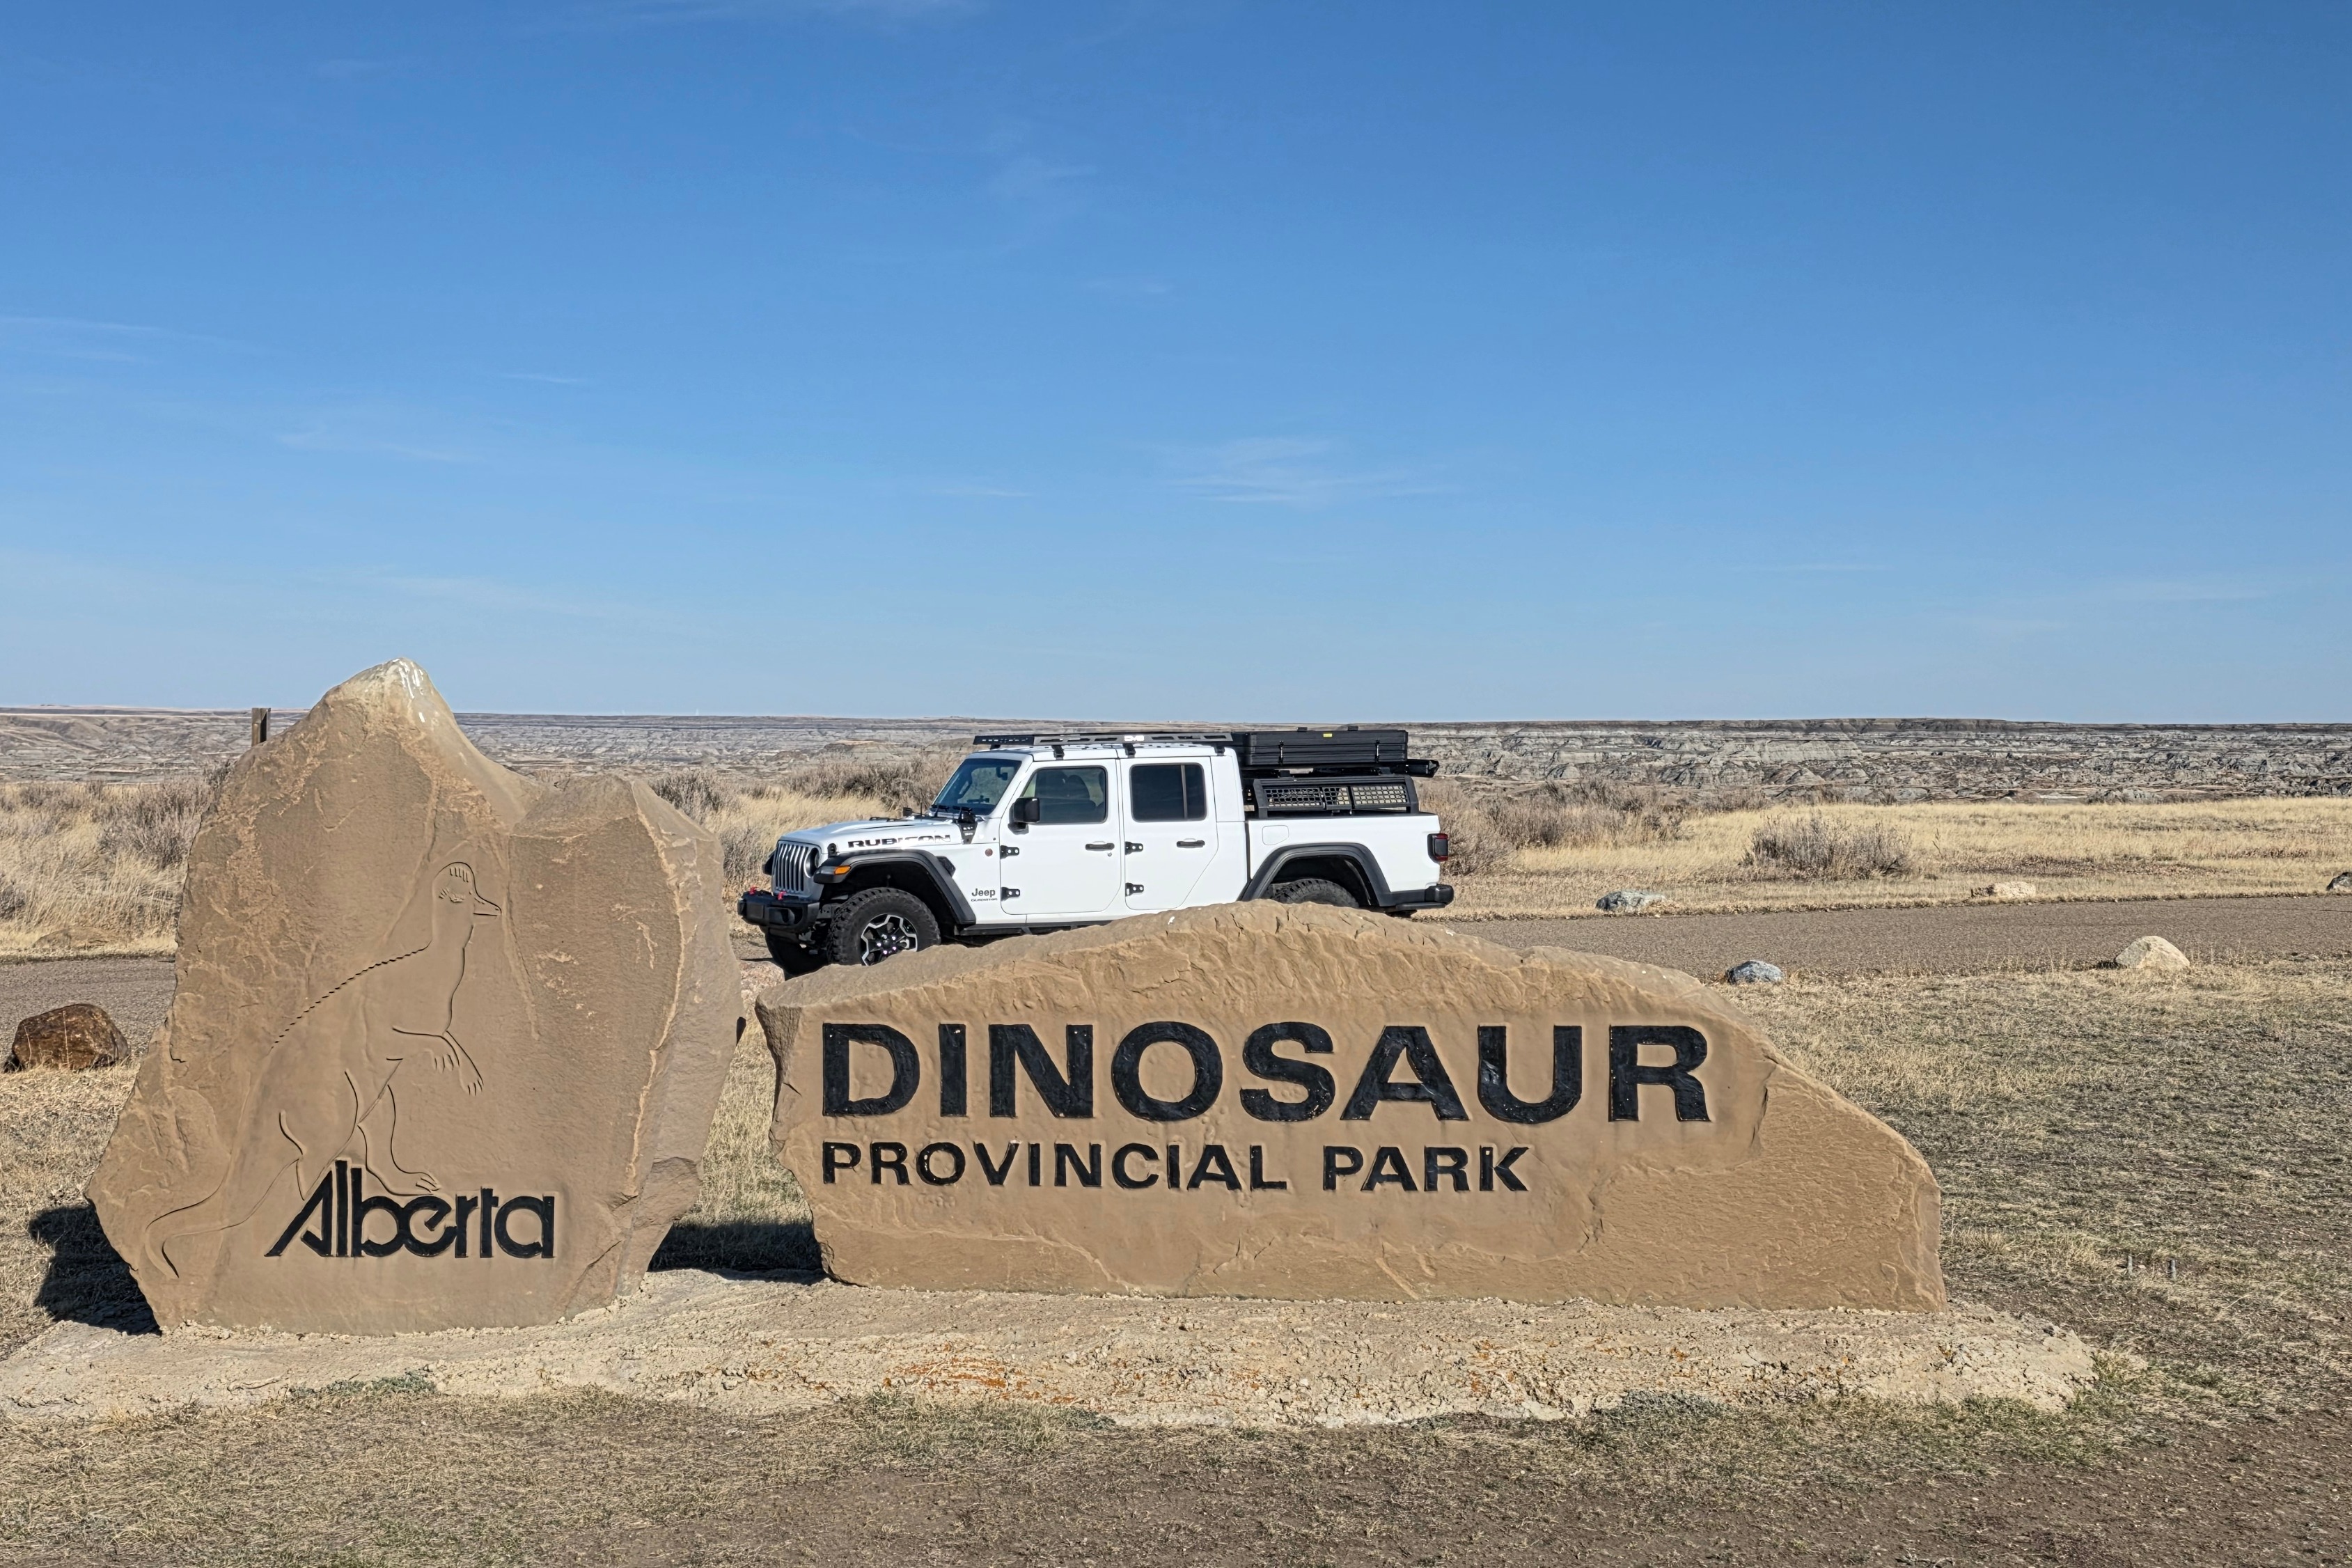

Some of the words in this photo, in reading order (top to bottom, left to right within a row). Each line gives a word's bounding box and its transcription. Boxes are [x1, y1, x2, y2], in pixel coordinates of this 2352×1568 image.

[971, 888, 996, 897] Jeep
[822, 1021, 1711, 1124] DINOSAUR
[822, 1141, 1287, 1191] PROVINCIAL
[1323, 1145, 1530, 1192] PARK
[265, 1159, 555, 1259] Alberta
